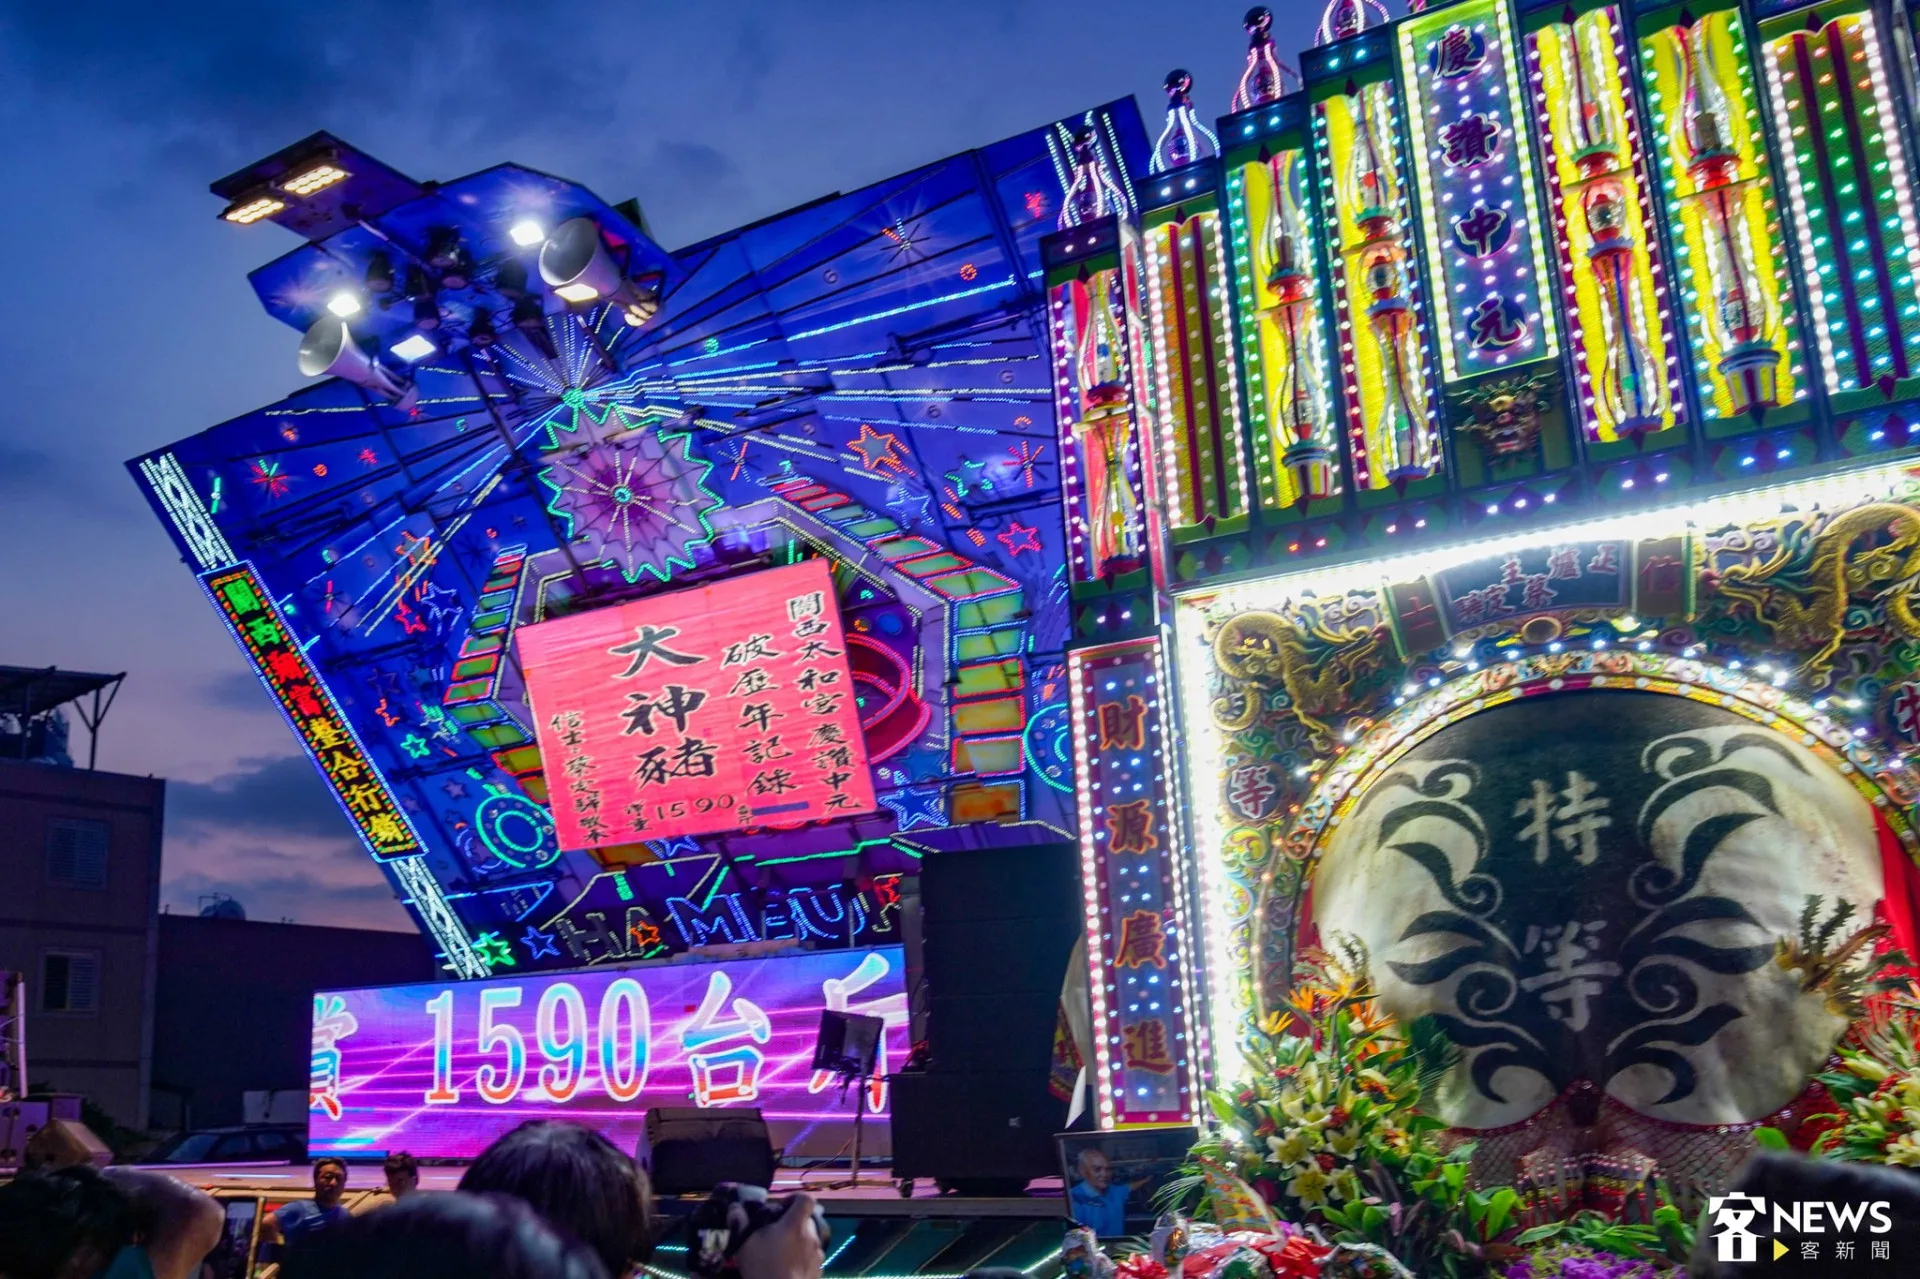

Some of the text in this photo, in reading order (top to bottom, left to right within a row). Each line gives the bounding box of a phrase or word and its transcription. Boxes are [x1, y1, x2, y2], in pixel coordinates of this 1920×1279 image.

[1433, 27, 1526, 349] 慶讚中元
[610, 626, 717, 788] 大神豬
[1229, 765, 1275, 818] 等
[1099, 695, 1174, 1074] 財源廣進
[1513, 770, 1622, 1031] 特等
